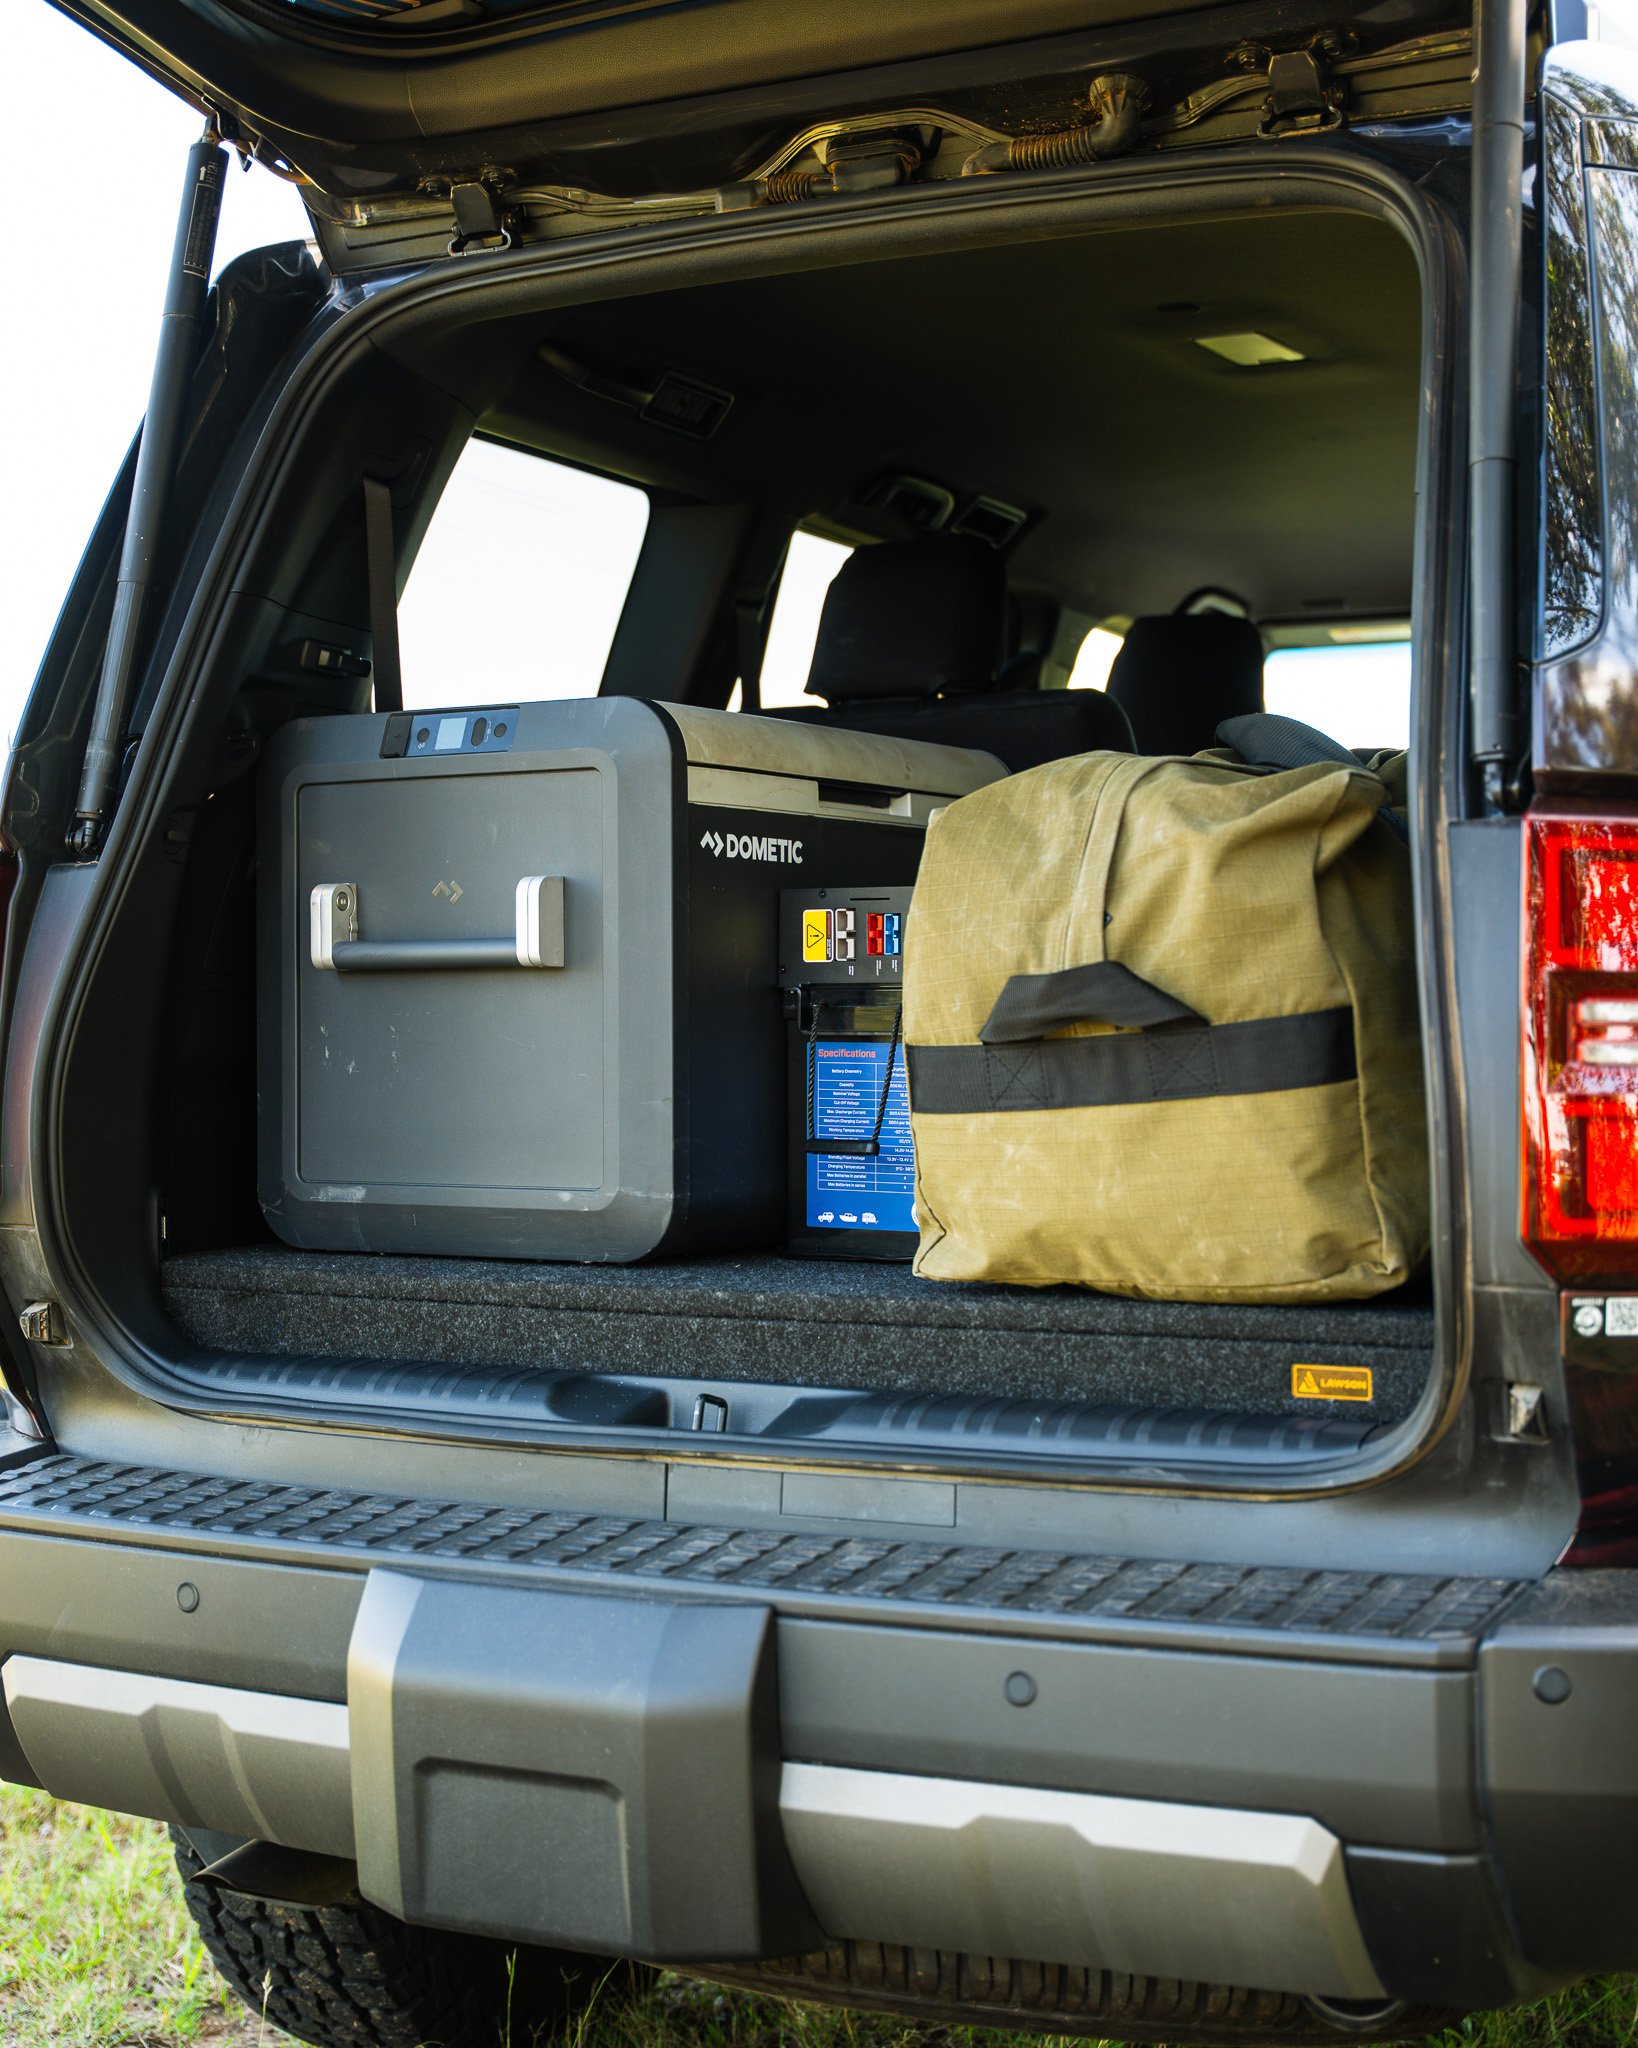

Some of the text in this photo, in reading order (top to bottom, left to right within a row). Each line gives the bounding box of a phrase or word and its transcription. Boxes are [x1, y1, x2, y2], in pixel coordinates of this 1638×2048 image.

[726, 833, 803, 864] DOMETIC
[818, 1049, 876, 1058] Specifications
[1319, 1377, 1367, 1390] LAWSON
